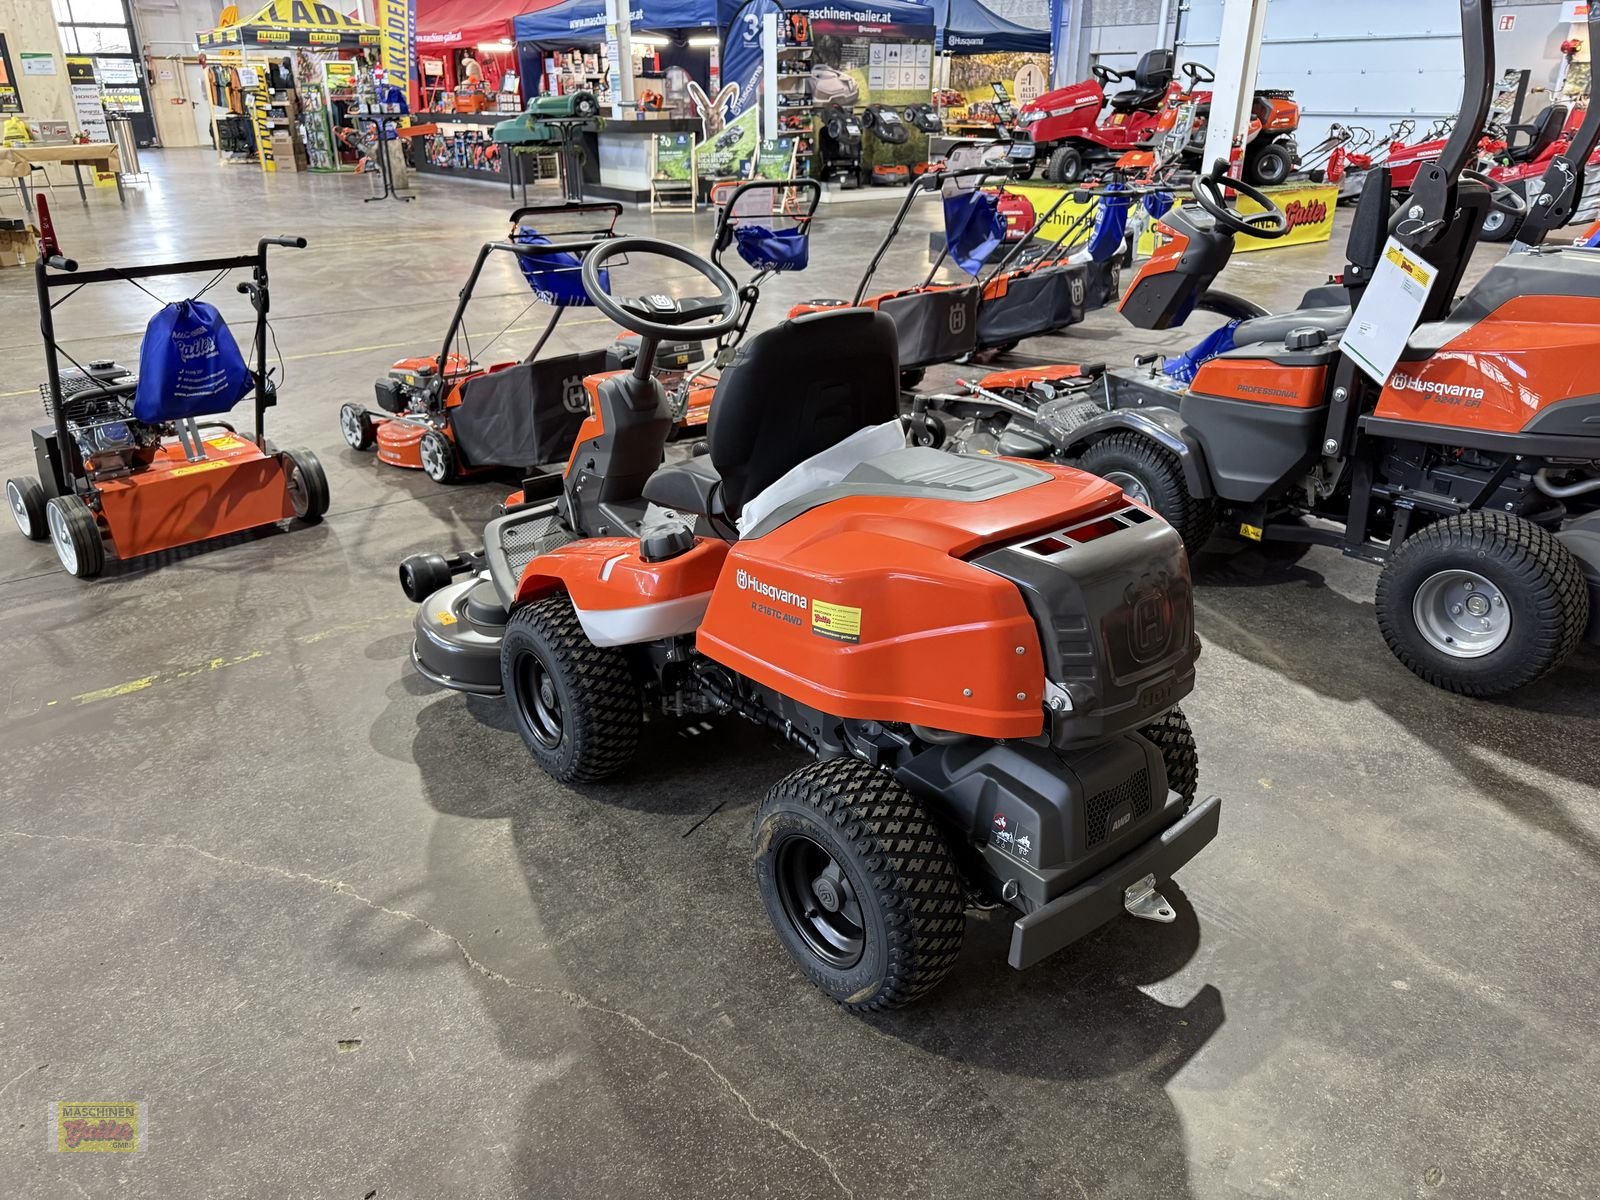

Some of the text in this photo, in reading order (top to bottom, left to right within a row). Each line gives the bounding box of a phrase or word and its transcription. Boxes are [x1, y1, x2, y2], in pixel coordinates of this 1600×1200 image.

[1075, 95, 1098, 104] HONDA
[1416, 149, 1443, 157] HONDA
[1407, 377, 1485, 400] Husqvarna
[747, 574, 808, 609] Husqvarna
[751, 601, 757, 611] R
[783, 613, 803, 626] AWD
[1112, 812, 1131, 832] AWD
